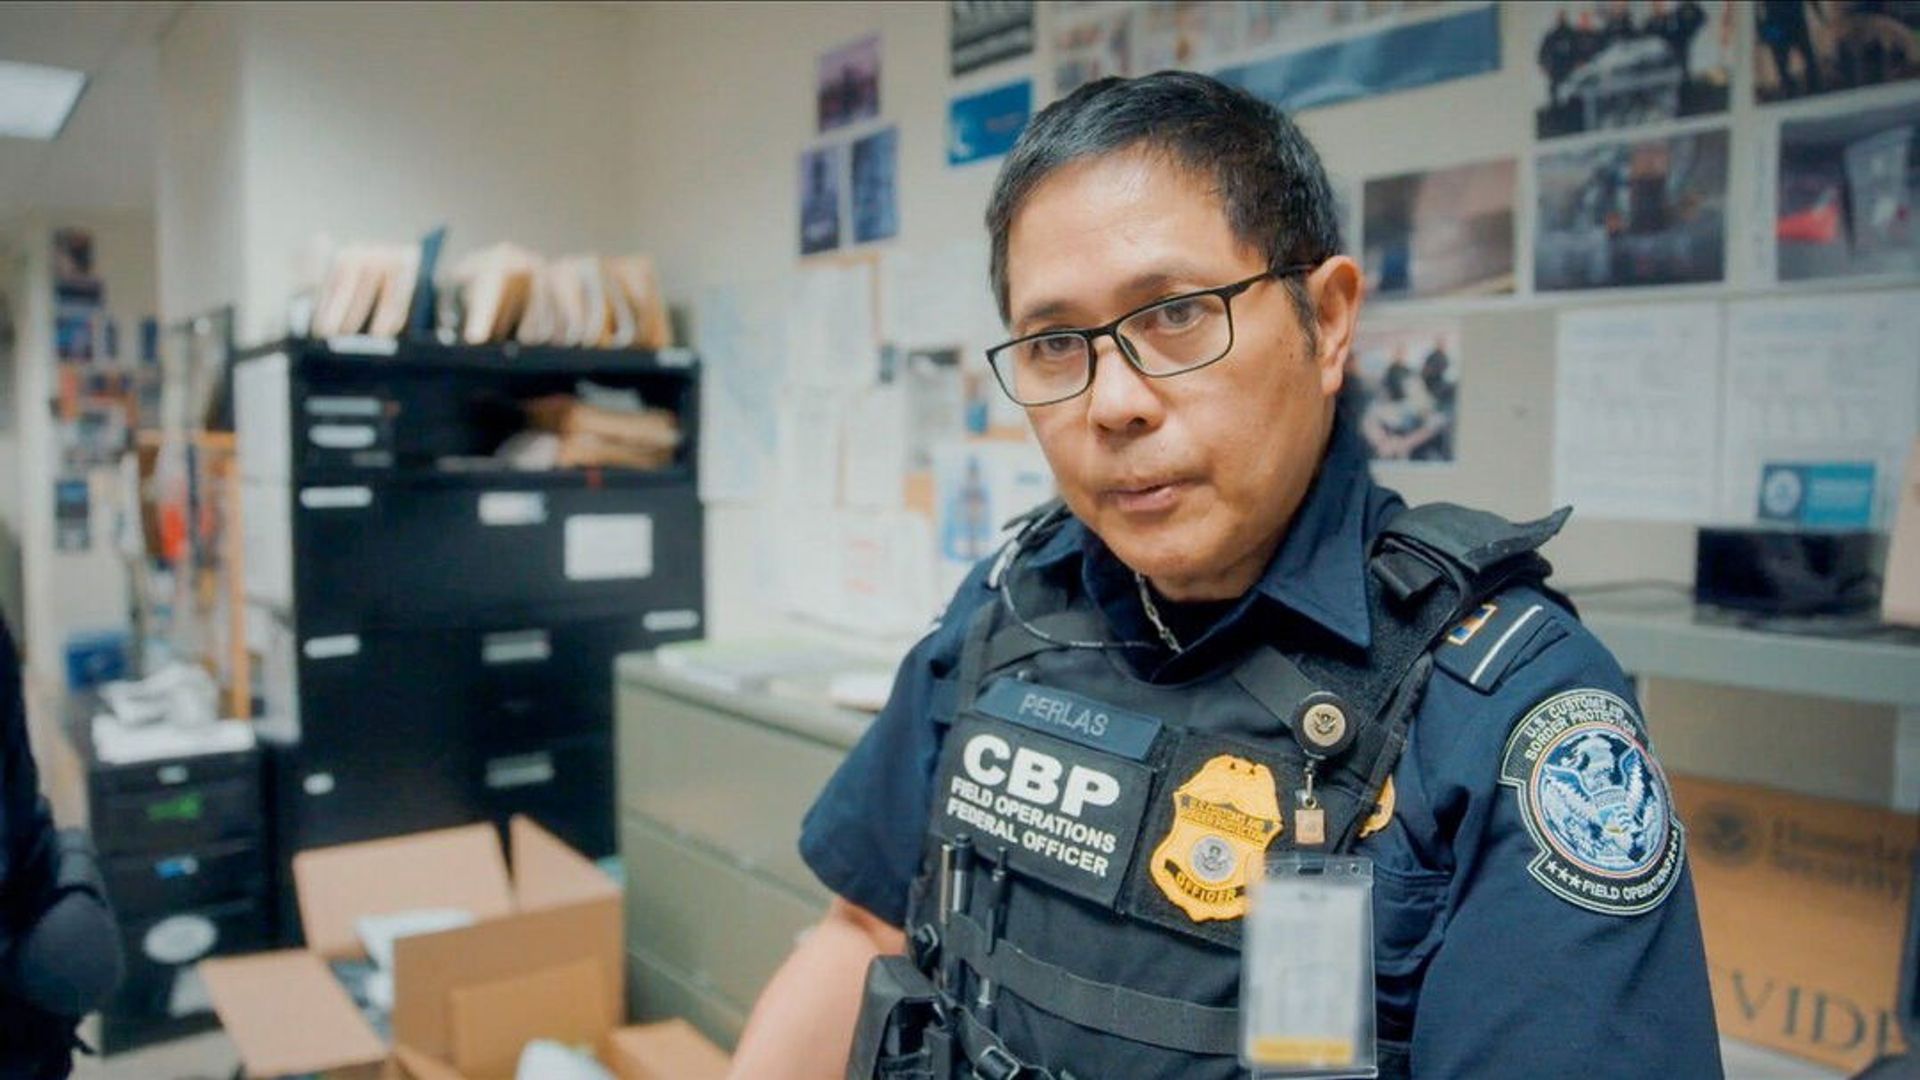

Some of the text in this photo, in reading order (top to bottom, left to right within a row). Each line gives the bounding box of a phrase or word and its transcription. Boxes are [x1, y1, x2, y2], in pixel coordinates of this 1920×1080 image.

[1018, 693, 1109, 736] PERLAS
[1549, 695, 1607, 719] CUSTOMS
[1525, 716, 1569, 761] BORDER
[963, 734, 1120, 817] CBP
[952, 776, 1117, 853] FIELD OPERATIONS
[946, 797, 1109, 877] FEDERAL OFFICER
[1177, 872, 1237, 904] OFFICER
[1582, 880, 1620, 900] FIELD
